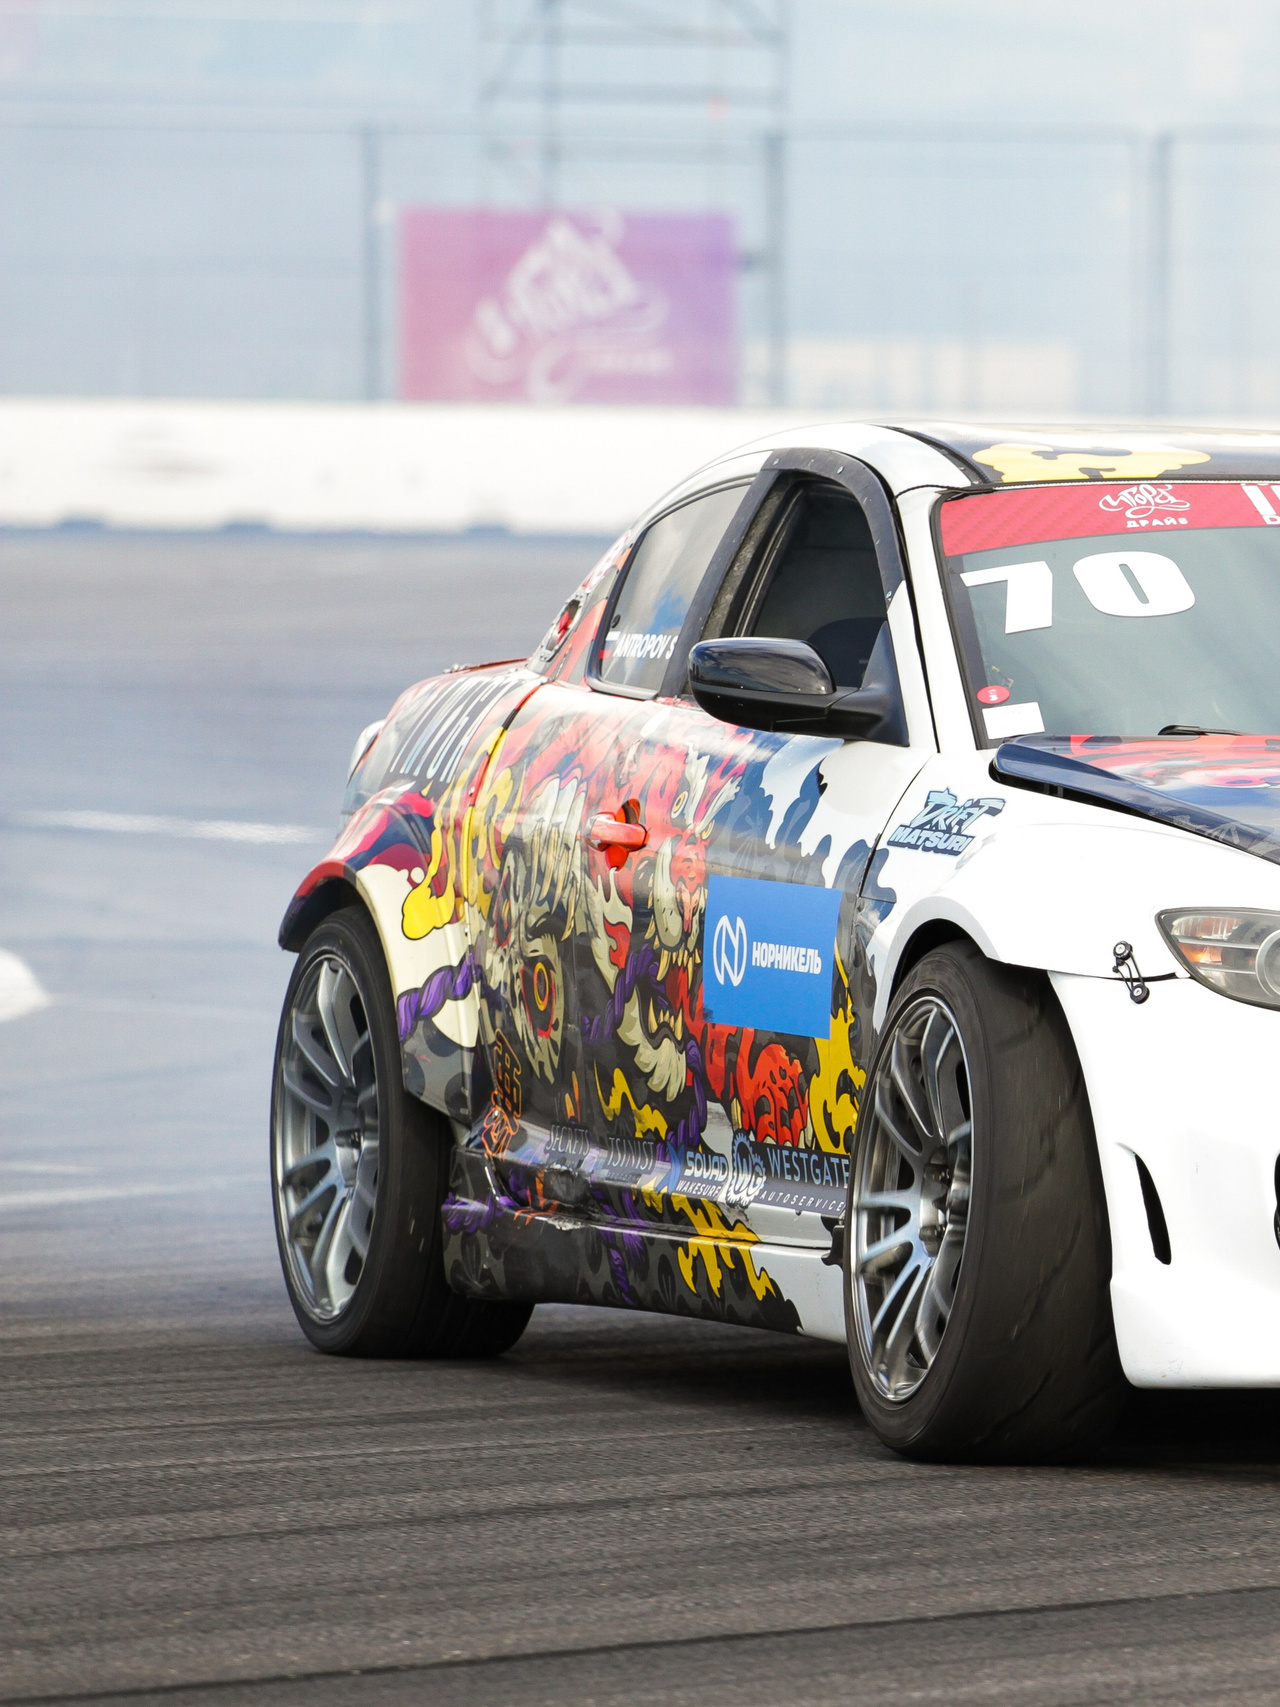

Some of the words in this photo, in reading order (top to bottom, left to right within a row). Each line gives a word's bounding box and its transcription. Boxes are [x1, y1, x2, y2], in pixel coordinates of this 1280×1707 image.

[612, 633, 672, 659] ANTROPOV
[665, 634, 679, 660] S
[887, 824, 976, 856] MATSURI
[751, 941, 822, 975] НОРНИКЕЛЬ
[545, 1124, 590, 1156] SECRETS
[767, 1147, 850, 1190] WESTGATE
[676, 1179, 722, 1199] WAKESURF
[760, 1189, 845, 1212] AUTOSERVICE
